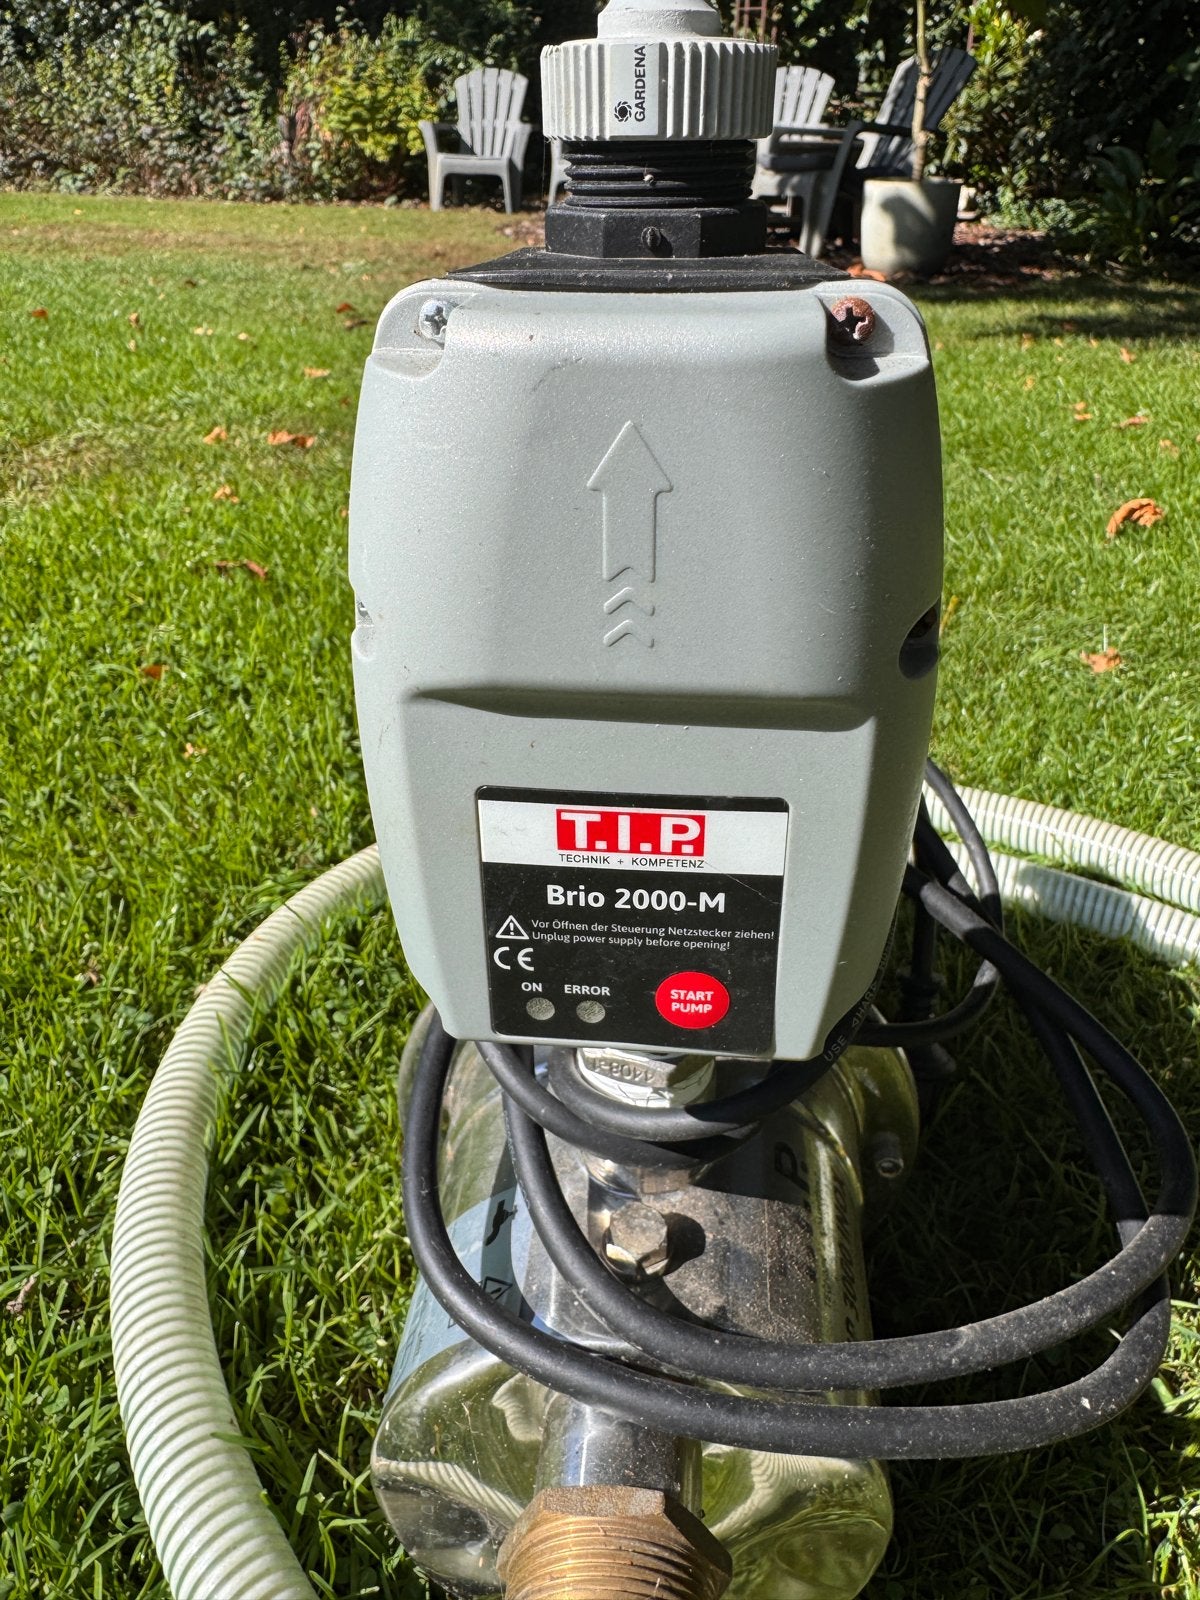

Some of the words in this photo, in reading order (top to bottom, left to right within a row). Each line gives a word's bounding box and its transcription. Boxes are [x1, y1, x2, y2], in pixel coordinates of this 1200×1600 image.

[634, 45, 646, 122] GARDENA
[560, 811, 702, 854] T.I.P.
[559, 853, 611, 865] TECHNIK
[631, 857, 705, 869] KOMPETENZ
[546, 884, 605, 908] Brio
[614, 888, 726, 913] 2000-M
[531, 919, 550, 929] Vor
[552, 919, 589, 931] Öffnen
[591, 922, 609, 932] der
[611, 923, 665, 937] Steuerung
[668, 926, 732, 938] Netzstecker
[734, 929, 775, 940] ziehen!
[532, 931, 571, 944] Unplug
[573, 934, 606, 944] power
[608, 936, 643, 947] supply
[645, 936, 681, 948] before
[683, 940, 730, 952] opening!
[521, 981, 543, 993] ON
[564, 984, 611, 996] ERROR
[670, 988, 714, 1002] START
[671, 1002, 713, 1014] PUMP
